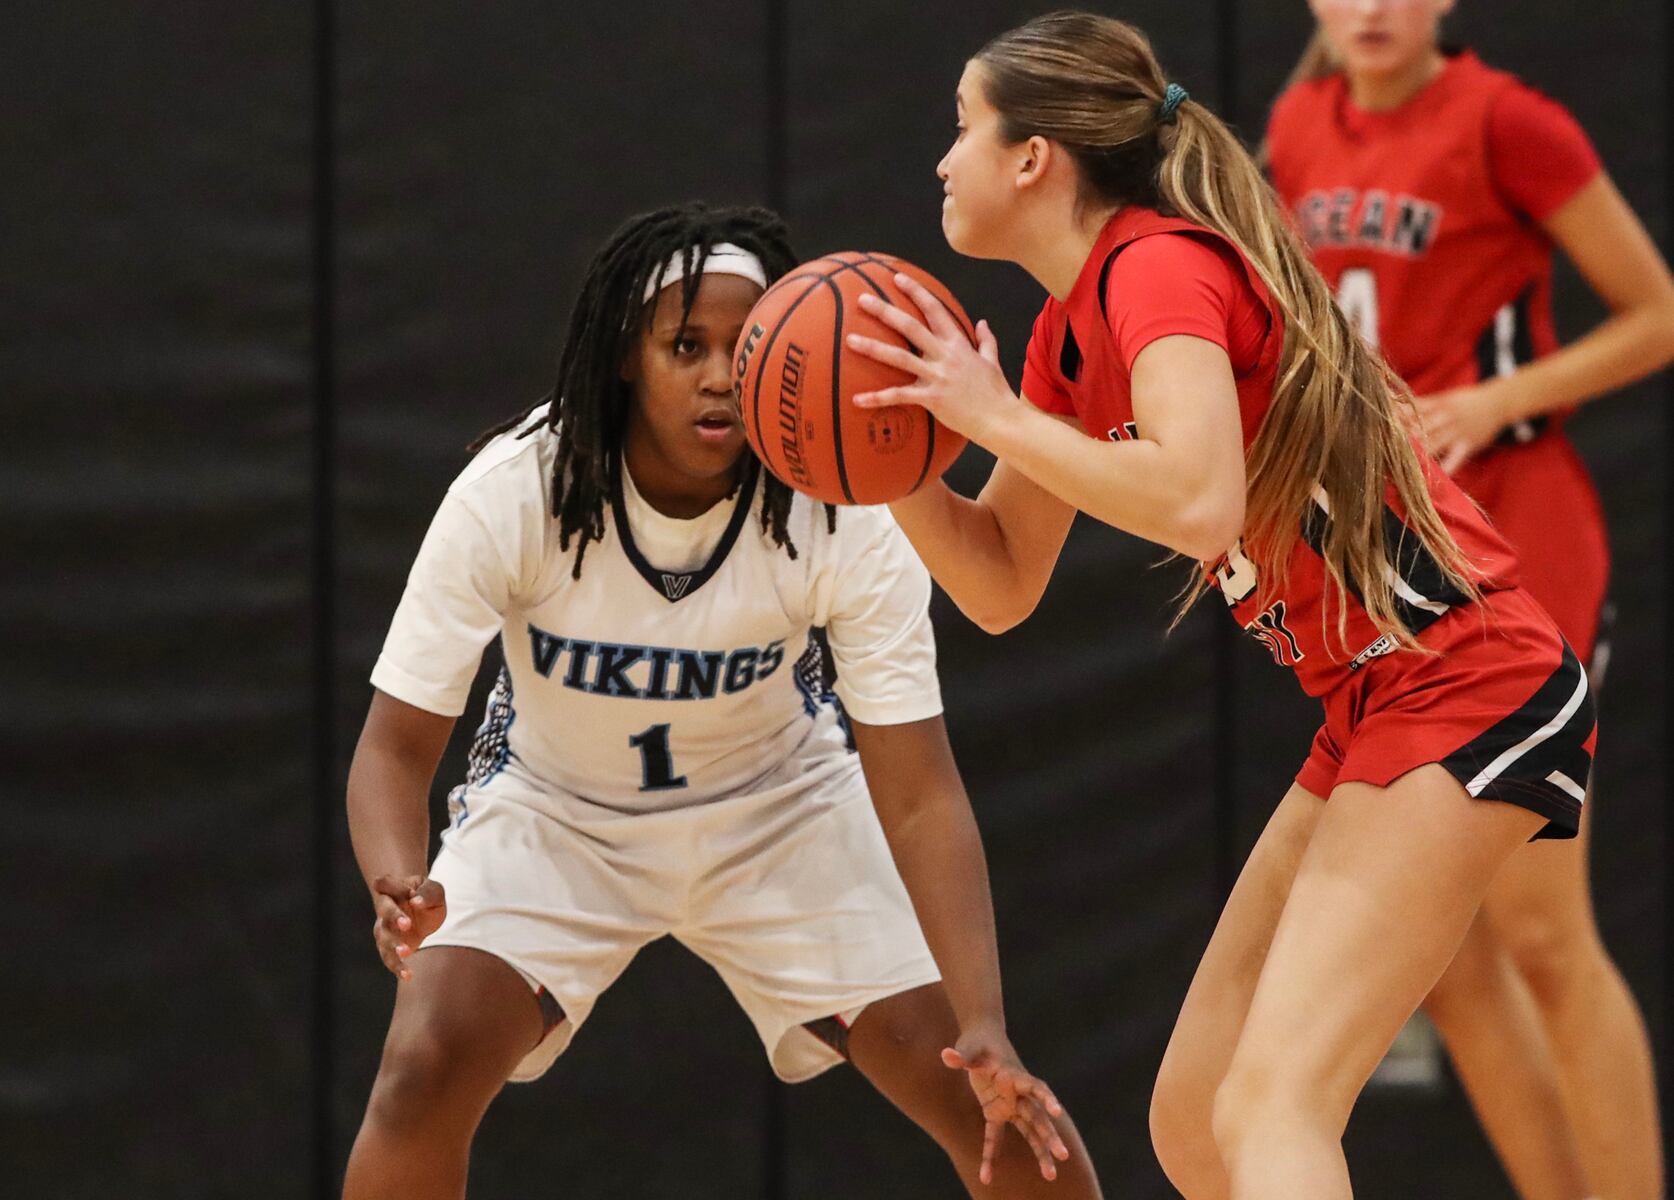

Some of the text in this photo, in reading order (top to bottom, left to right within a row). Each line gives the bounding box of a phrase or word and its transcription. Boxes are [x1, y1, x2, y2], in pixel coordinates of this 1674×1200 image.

[1296, 186, 1443, 261] CEAN
[779, 342, 811, 486] EVOLUTION
[661, 574, 692, 599] V
[527, 622, 787, 701] VIKINGS
[628, 723, 688, 792] 1
